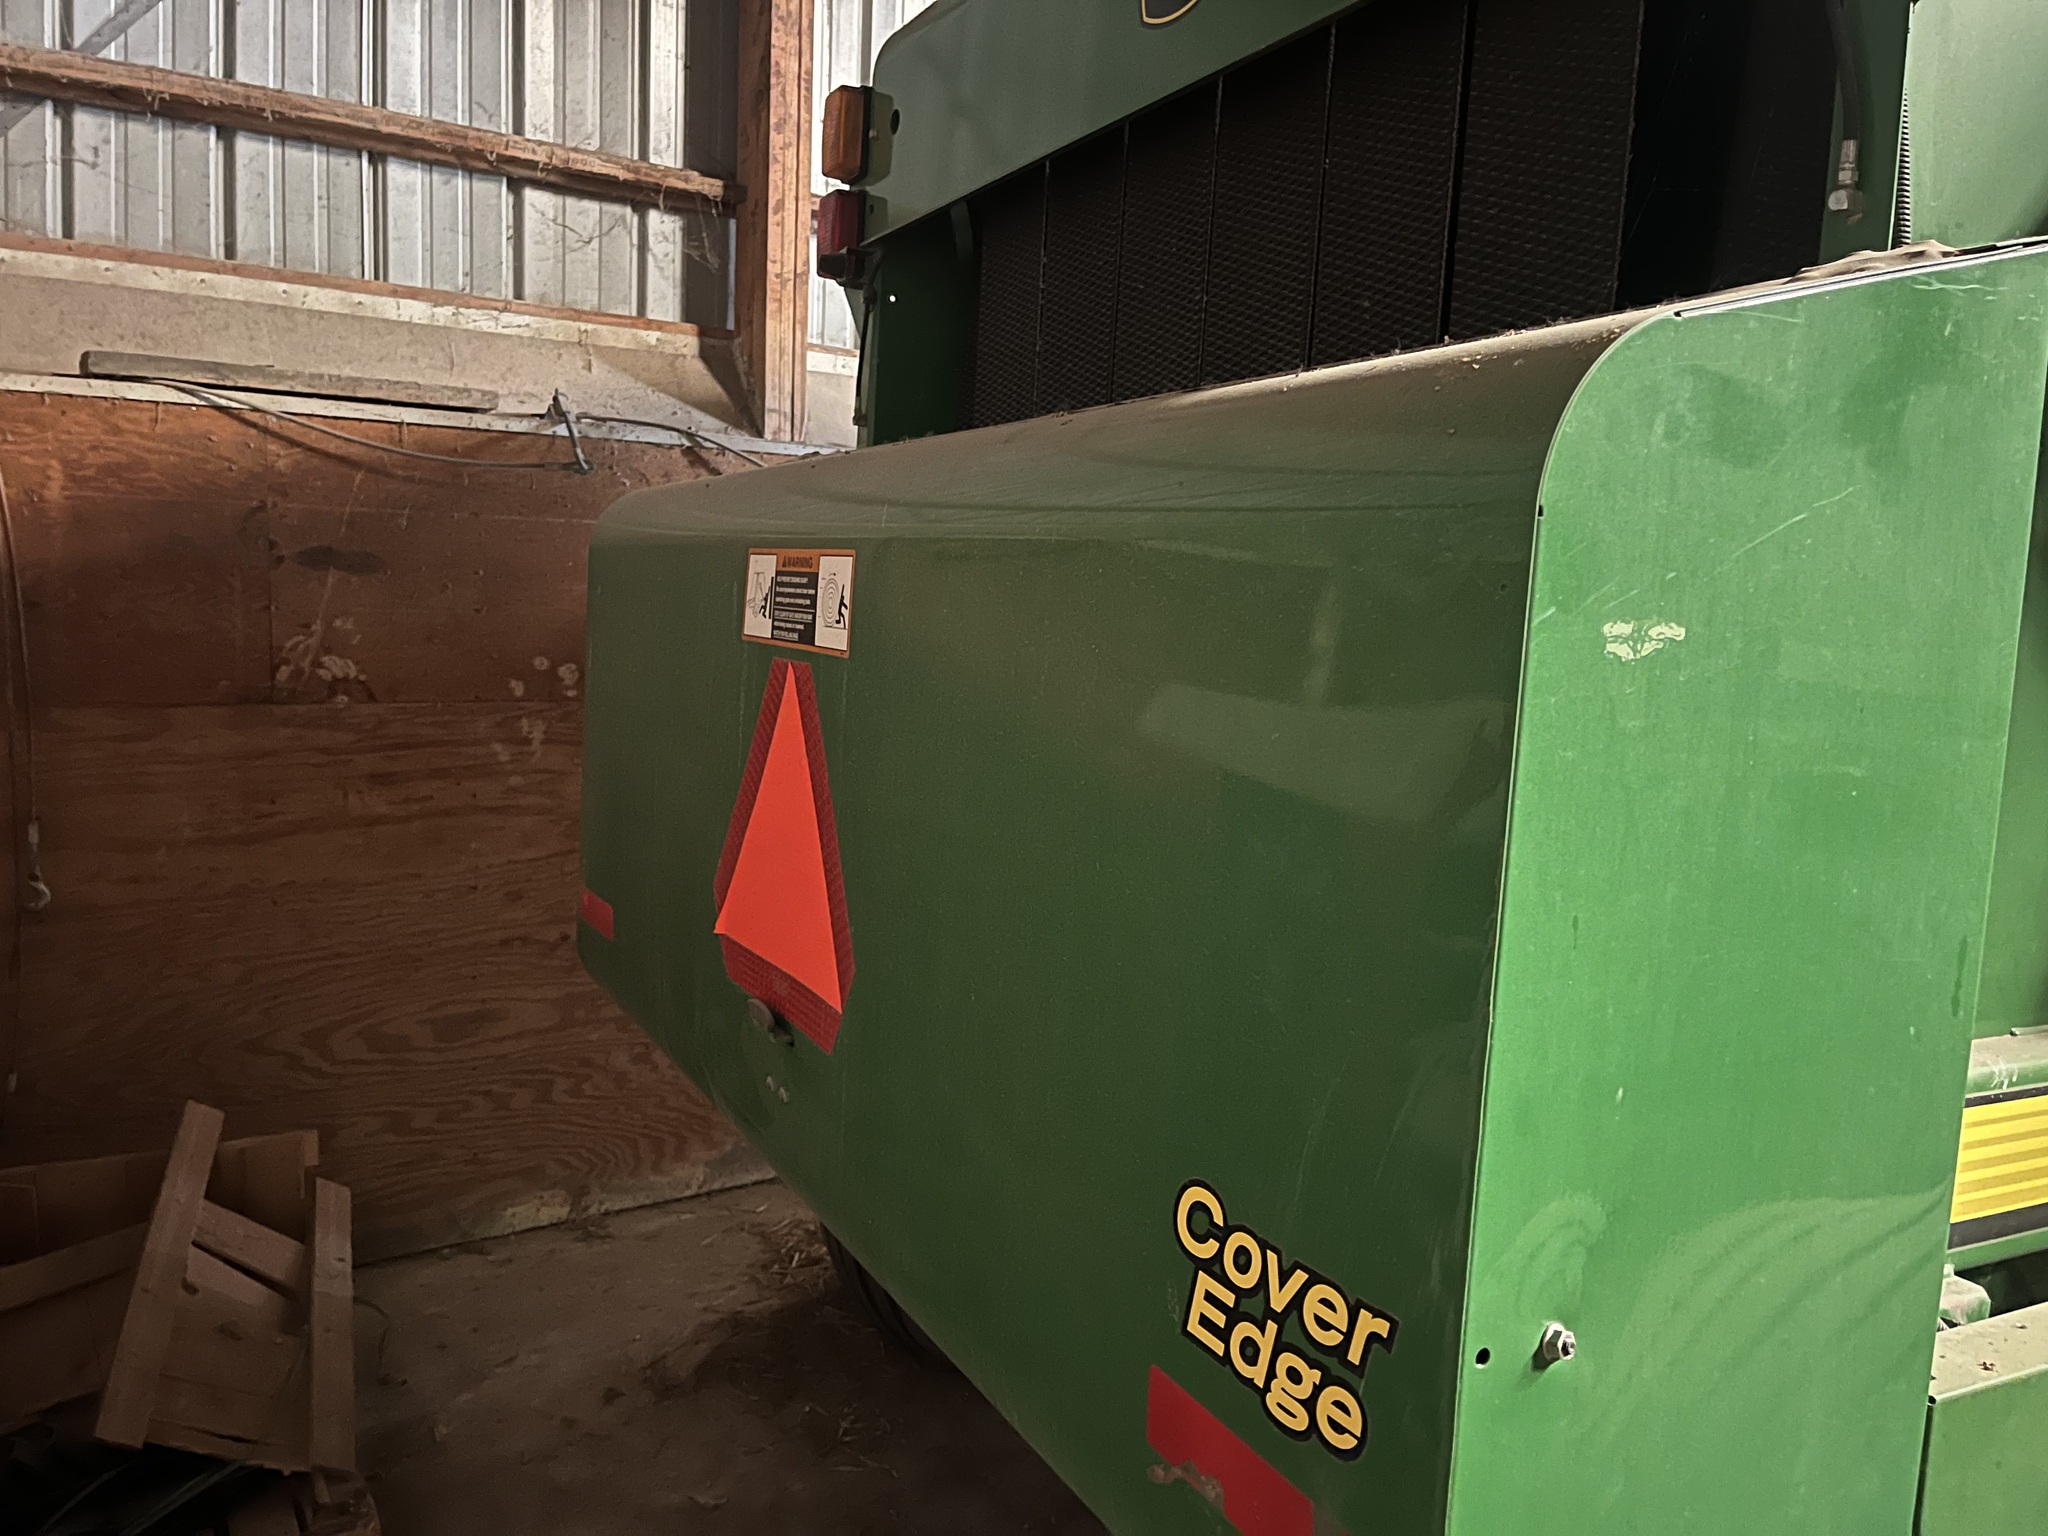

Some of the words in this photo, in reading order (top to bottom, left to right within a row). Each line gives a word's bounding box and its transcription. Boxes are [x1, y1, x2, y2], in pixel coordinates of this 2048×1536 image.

[787, 556, 813, 568] WARNING
[1177, 1186, 1390, 1365] Cover
[1187, 1270, 1363, 1450] Edge
